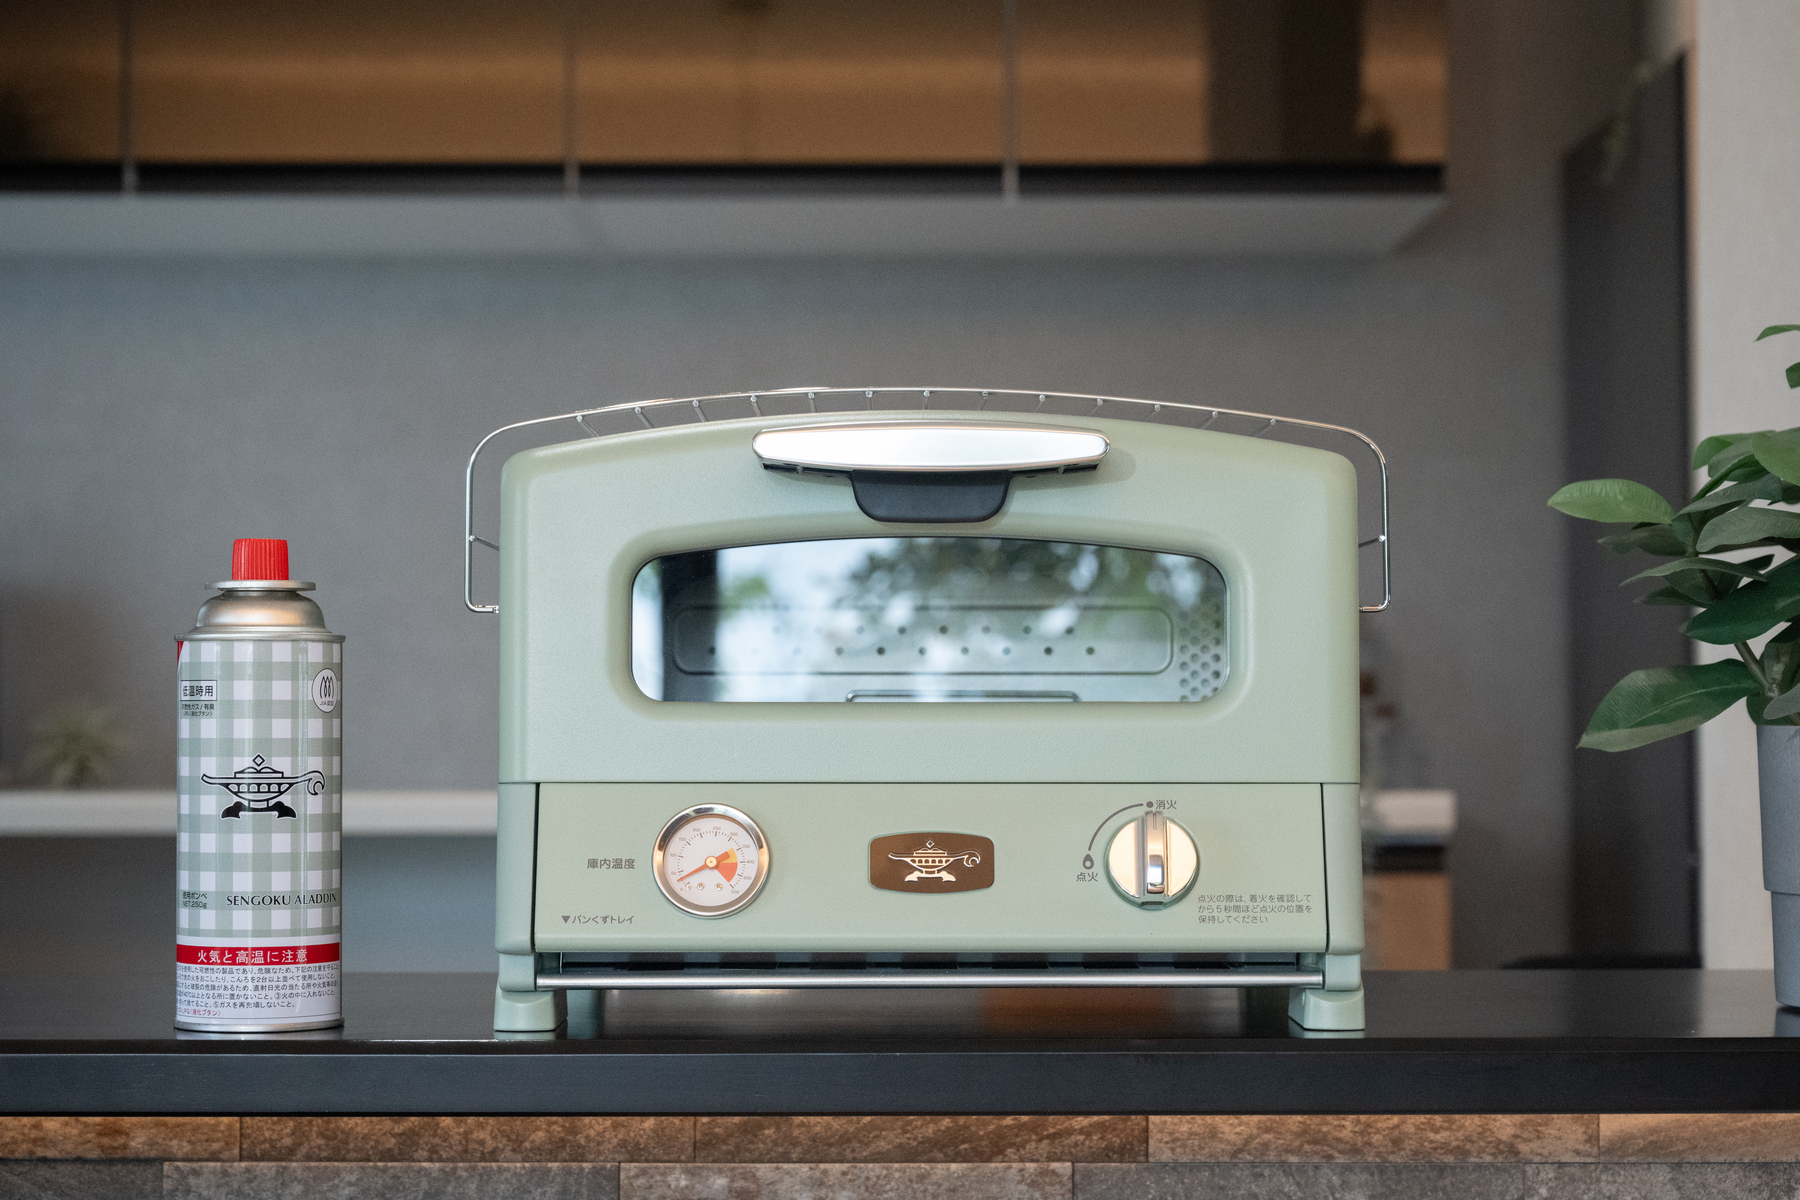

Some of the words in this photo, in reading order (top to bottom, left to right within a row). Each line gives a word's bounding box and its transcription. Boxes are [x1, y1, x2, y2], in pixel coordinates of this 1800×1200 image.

[1155, 799, 1177, 810] 消火
[586, 858, 636, 870] 庫内温度
[1076, 872, 1099, 883] 点火
[226, 894, 291, 906] SENGOKU
[294, 892, 337, 905] ALADDIN
[1197, 894, 1312, 903] 点火の際は、着火を確認して
[1197, 904, 1313, 914] から5秒間ほど点火の位置を
[571, 915, 635, 925] パンくずトレイ
[1198, 915, 1268, 924] 保持してください
[197, 948, 308, 964] 火気と高温に注意
